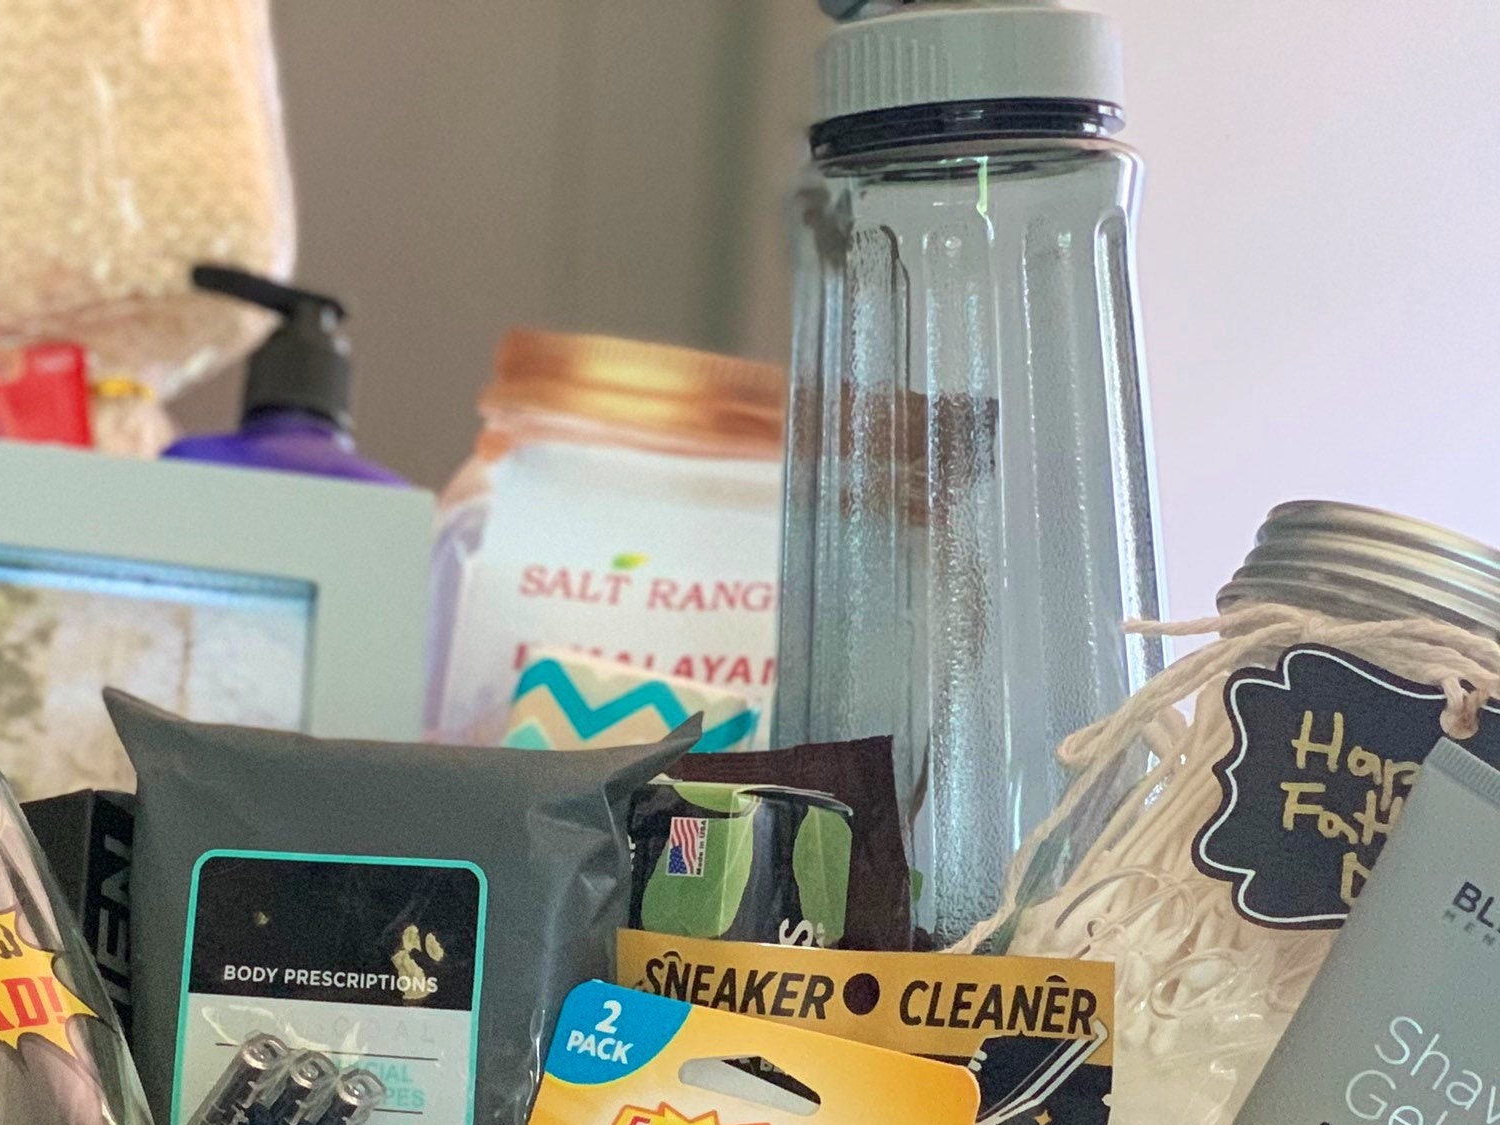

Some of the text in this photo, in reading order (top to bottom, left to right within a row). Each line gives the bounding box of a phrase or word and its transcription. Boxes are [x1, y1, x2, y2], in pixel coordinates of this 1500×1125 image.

[519, 564, 778, 612] SALT RANG
[1291, 710, 1424, 811] Hap
[224, 965, 439, 994] BODY PRESCRIPTIONS
[595, 1000, 623, 1034] 2
[566, 1030, 634, 1065] PACK
[1374, 1016, 1500, 1125] Shav
